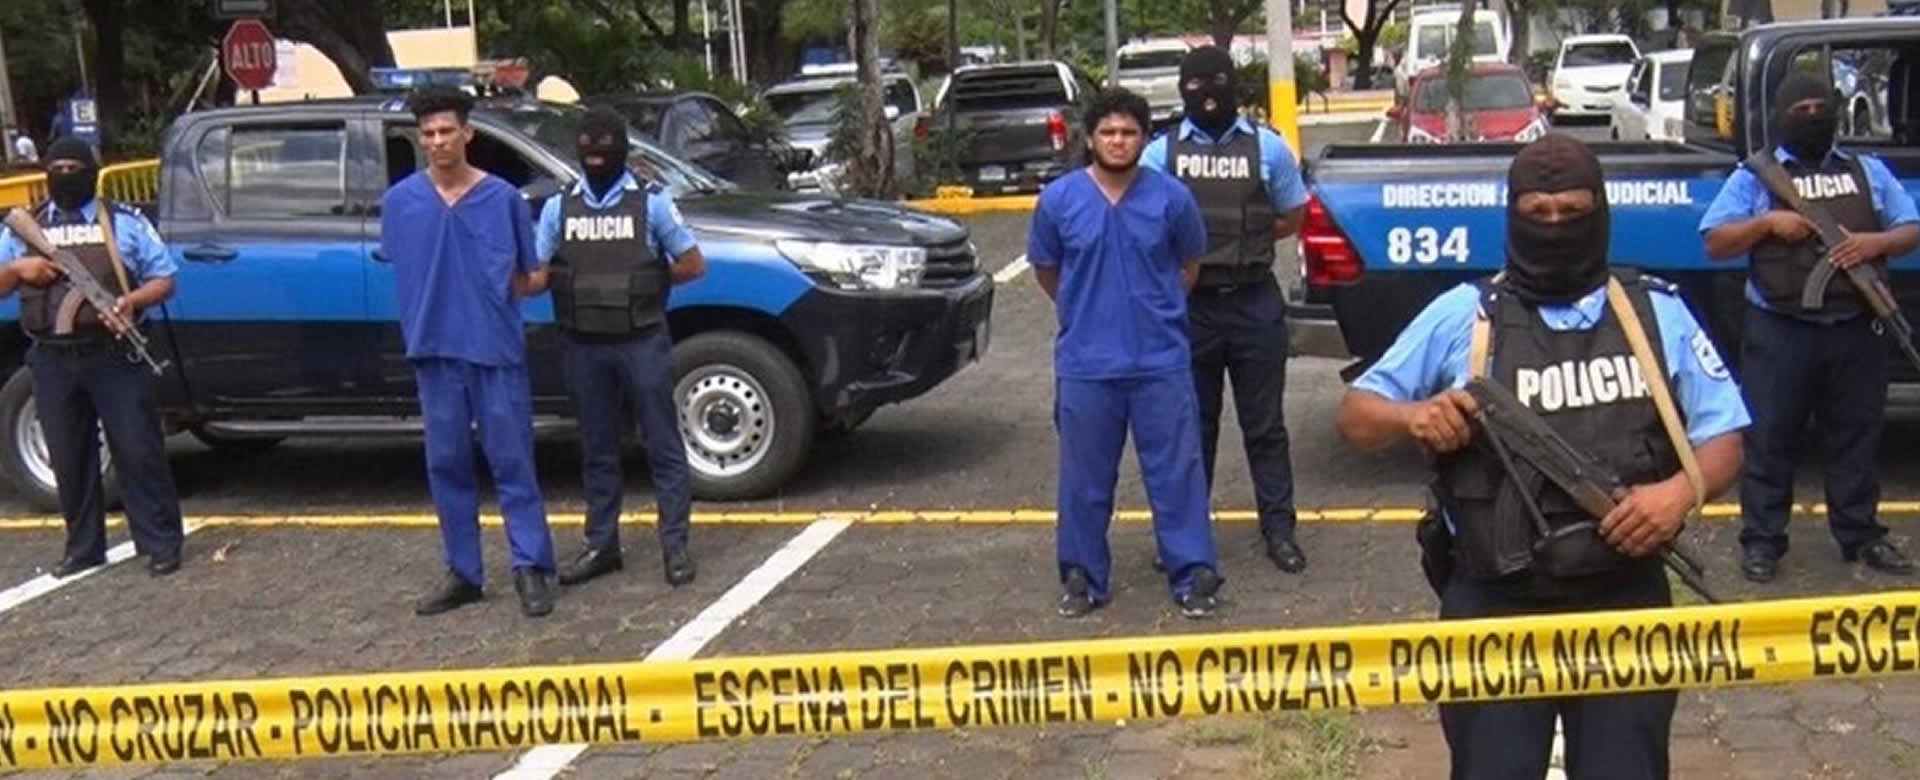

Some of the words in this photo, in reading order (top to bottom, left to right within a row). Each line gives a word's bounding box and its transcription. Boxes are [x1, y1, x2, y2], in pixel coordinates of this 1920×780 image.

[231, 41, 272, 70] ALTO
[1176, 153, 1250, 179] POLICIA
[1382, 183, 1498, 208] DIRECCION
[1603, 180, 1693, 205] UDICIAL
[1791, 172, 1859, 199] OLICIA
[564, 214, 635, 241] POLICIA
[1387, 226, 1470, 263] 834
[1516, 355, 1652, 411] POLICIA
[44, 697, 99, 764] NO
[110, 691, 262, 763] CRUZAR
[289, 685, 439, 756] POLICIA
[444, 674, 641, 749] NACIONAL
[694, 665, 851, 738] ESCENA
[858, 661, 935, 731] DEL
[944, 655, 1094, 727] CRIMEN
[1128, 648, 1184, 718] NO
[1196, 641, 1358, 714] CRUZAR
[1390, 631, 1544, 705] POLICIA
[1553, 619, 1756, 692] NACIONAL
[1810, 604, 1920, 676] ESCE
